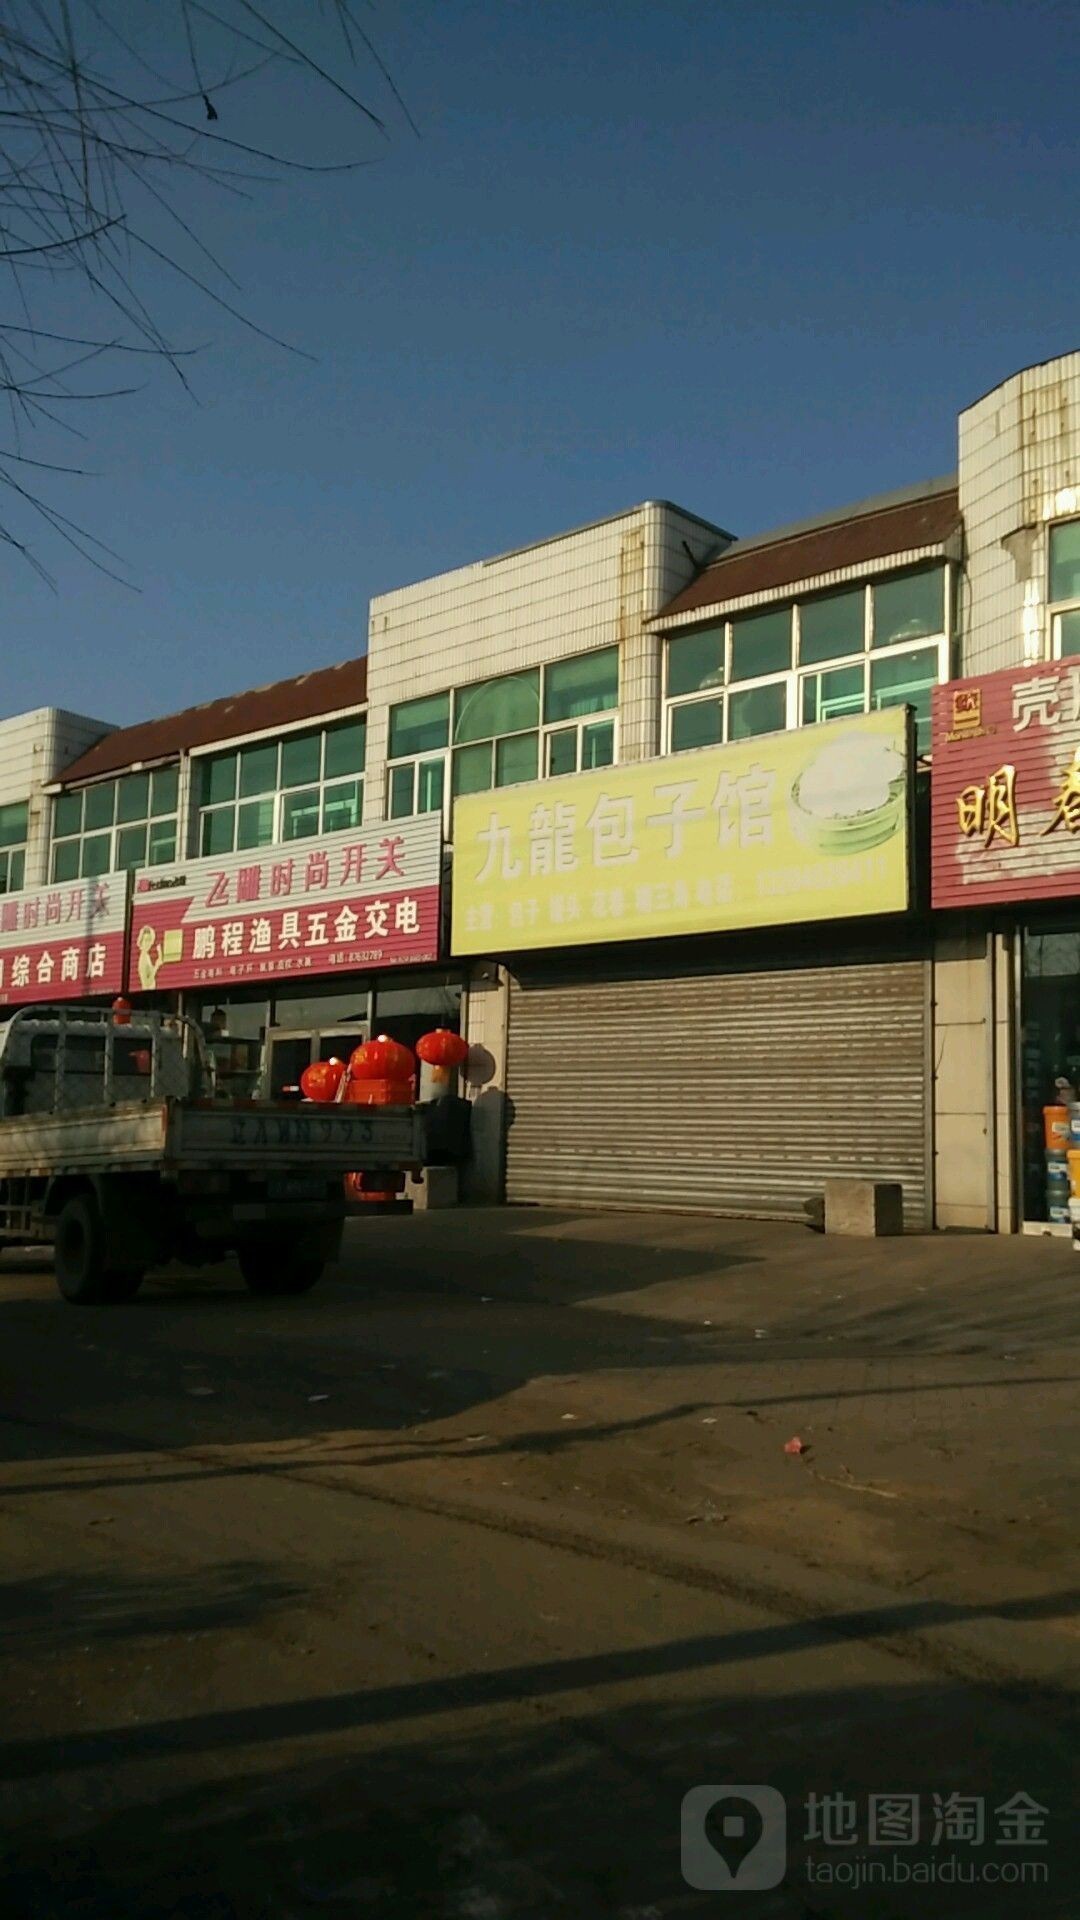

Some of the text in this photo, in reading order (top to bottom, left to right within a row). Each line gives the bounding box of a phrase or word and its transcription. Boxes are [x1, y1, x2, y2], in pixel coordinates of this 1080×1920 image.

[475, 763, 775, 883] 九龍包子馆
[191, 896, 421, 960] 鹏程渔具五金交电
